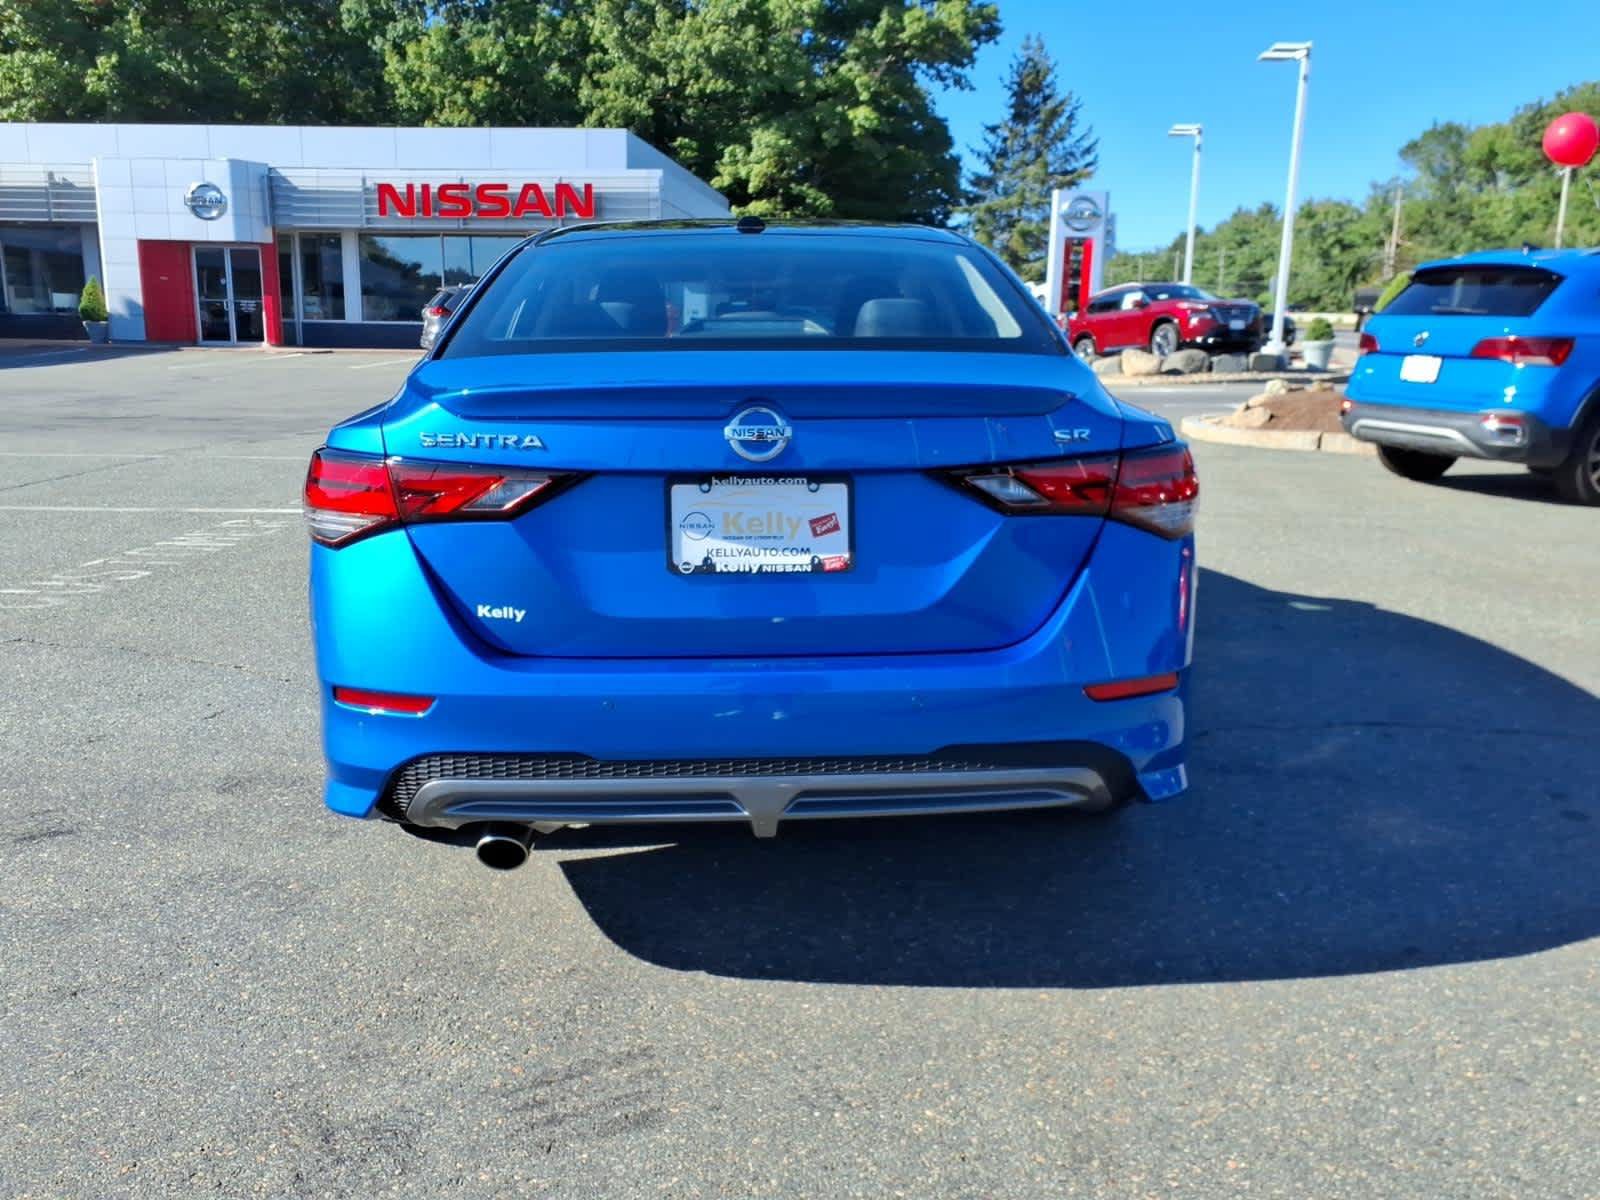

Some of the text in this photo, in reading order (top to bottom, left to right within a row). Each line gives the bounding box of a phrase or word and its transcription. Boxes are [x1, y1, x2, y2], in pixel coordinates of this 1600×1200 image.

[377, 183, 595, 218] NISSAN
[419, 431, 545, 449] SENTRA
[732, 427, 786, 438] NISSAN
[1053, 428, 1091, 442] SR
[722, 511, 802, 541] Kelly
[706, 547, 812, 558] KELLYAUTO.COM
[714, 561, 812, 574] Kelly NISSAN
[477, 604, 527, 622] Kelly
